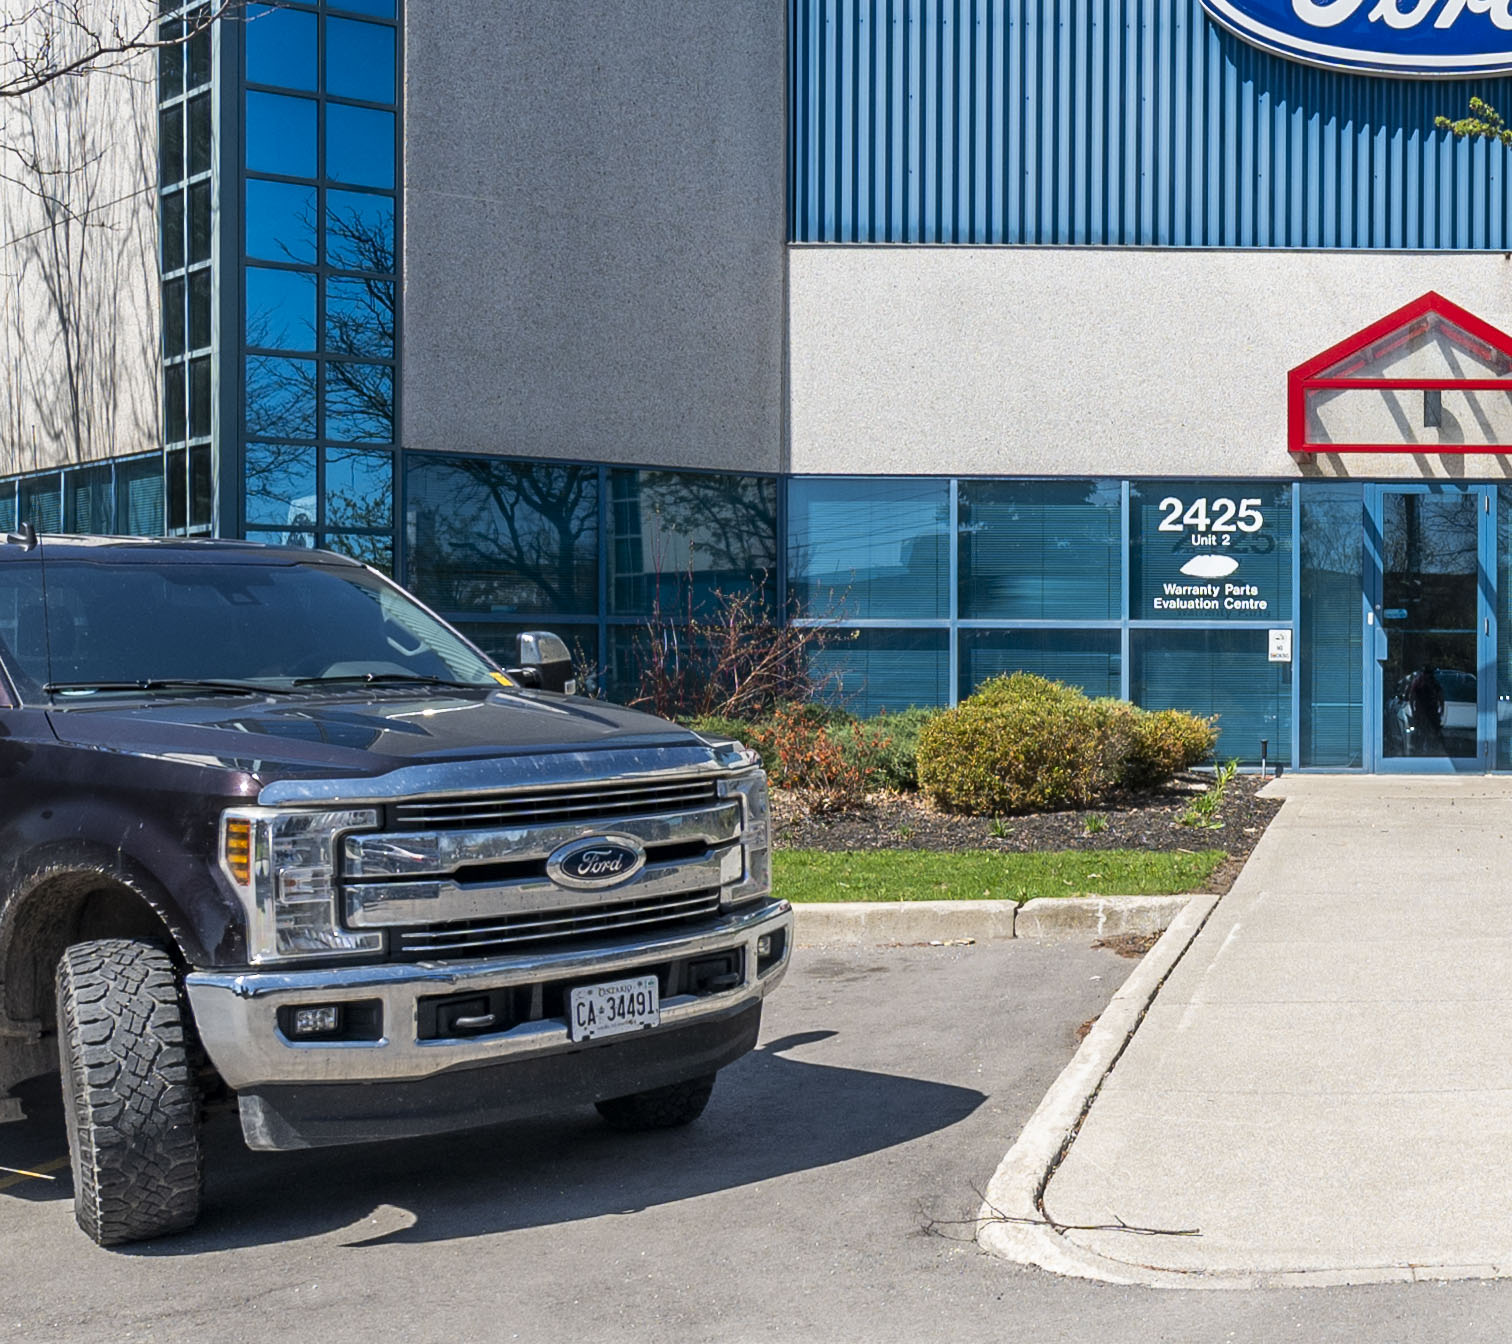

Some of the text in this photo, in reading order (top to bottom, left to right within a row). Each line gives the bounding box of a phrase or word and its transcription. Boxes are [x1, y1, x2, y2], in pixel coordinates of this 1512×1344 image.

[1158, 497, 1263, 533] 2425
[1191, 534, 1231, 546] Unit 2
[1163, 584, 1258, 598] Warranty Parts
[1153, 597, 1267, 609] Evaluation Centre
[577, 850, 623, 875] Ford
[577, 990, 654, 1027] CA 34491
